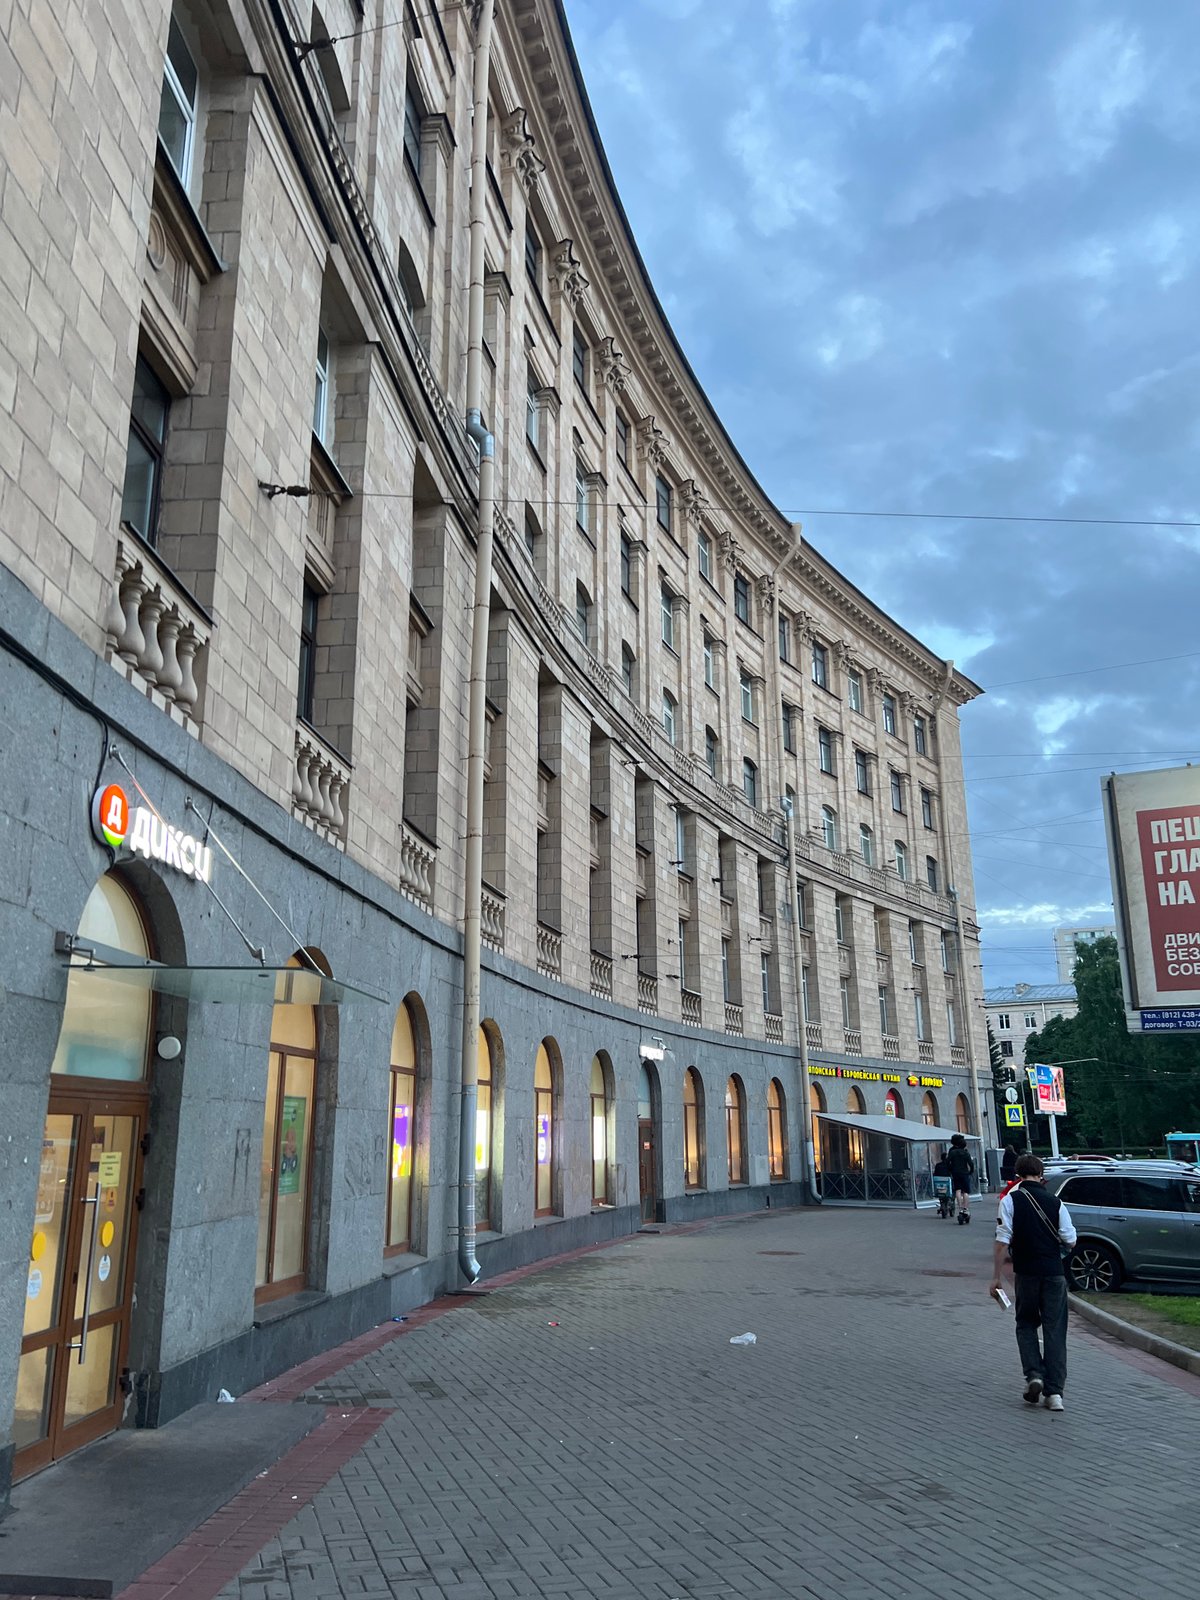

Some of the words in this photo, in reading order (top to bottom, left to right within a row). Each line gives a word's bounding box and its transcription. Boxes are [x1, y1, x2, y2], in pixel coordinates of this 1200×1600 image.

[130, 806, 210, 884] ДИКСИ
[1158, 880, 1196, 906] НА
[1164, 932, 1200, 948] ДВИ
[1166, 947, 1200, 961] БЕЗ
